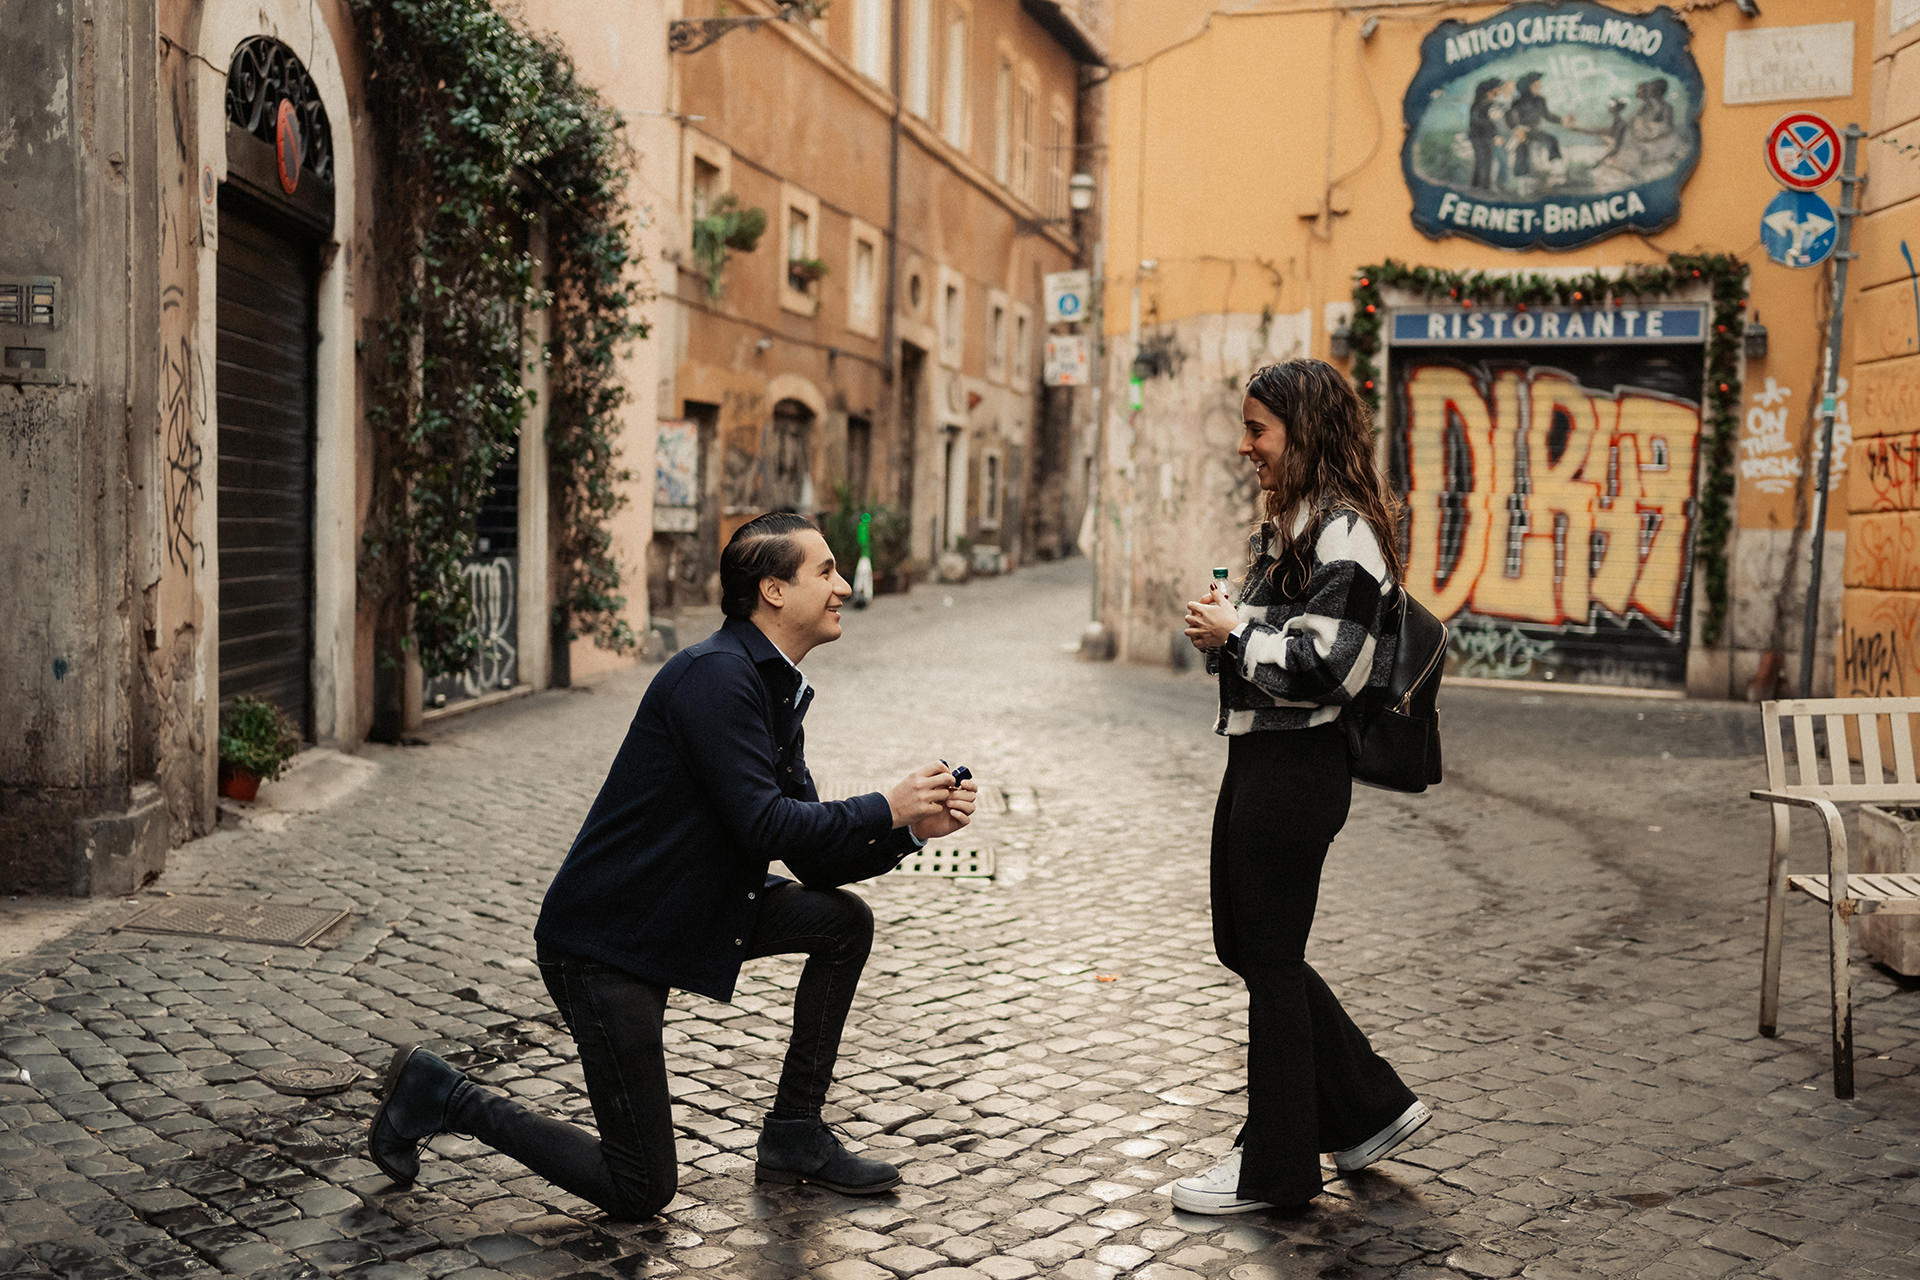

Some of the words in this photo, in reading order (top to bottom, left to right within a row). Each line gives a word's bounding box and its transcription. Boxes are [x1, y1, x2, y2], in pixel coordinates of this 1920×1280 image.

[1446, 21, 1515, 64] ANTICO
[1601, 18, 1663, 56] MORO
[1772, 40, 1805, 55] VIA
[1428, 310, 1663, 339] RISTORANTE
[1747, 407, 1788, 435] ON
